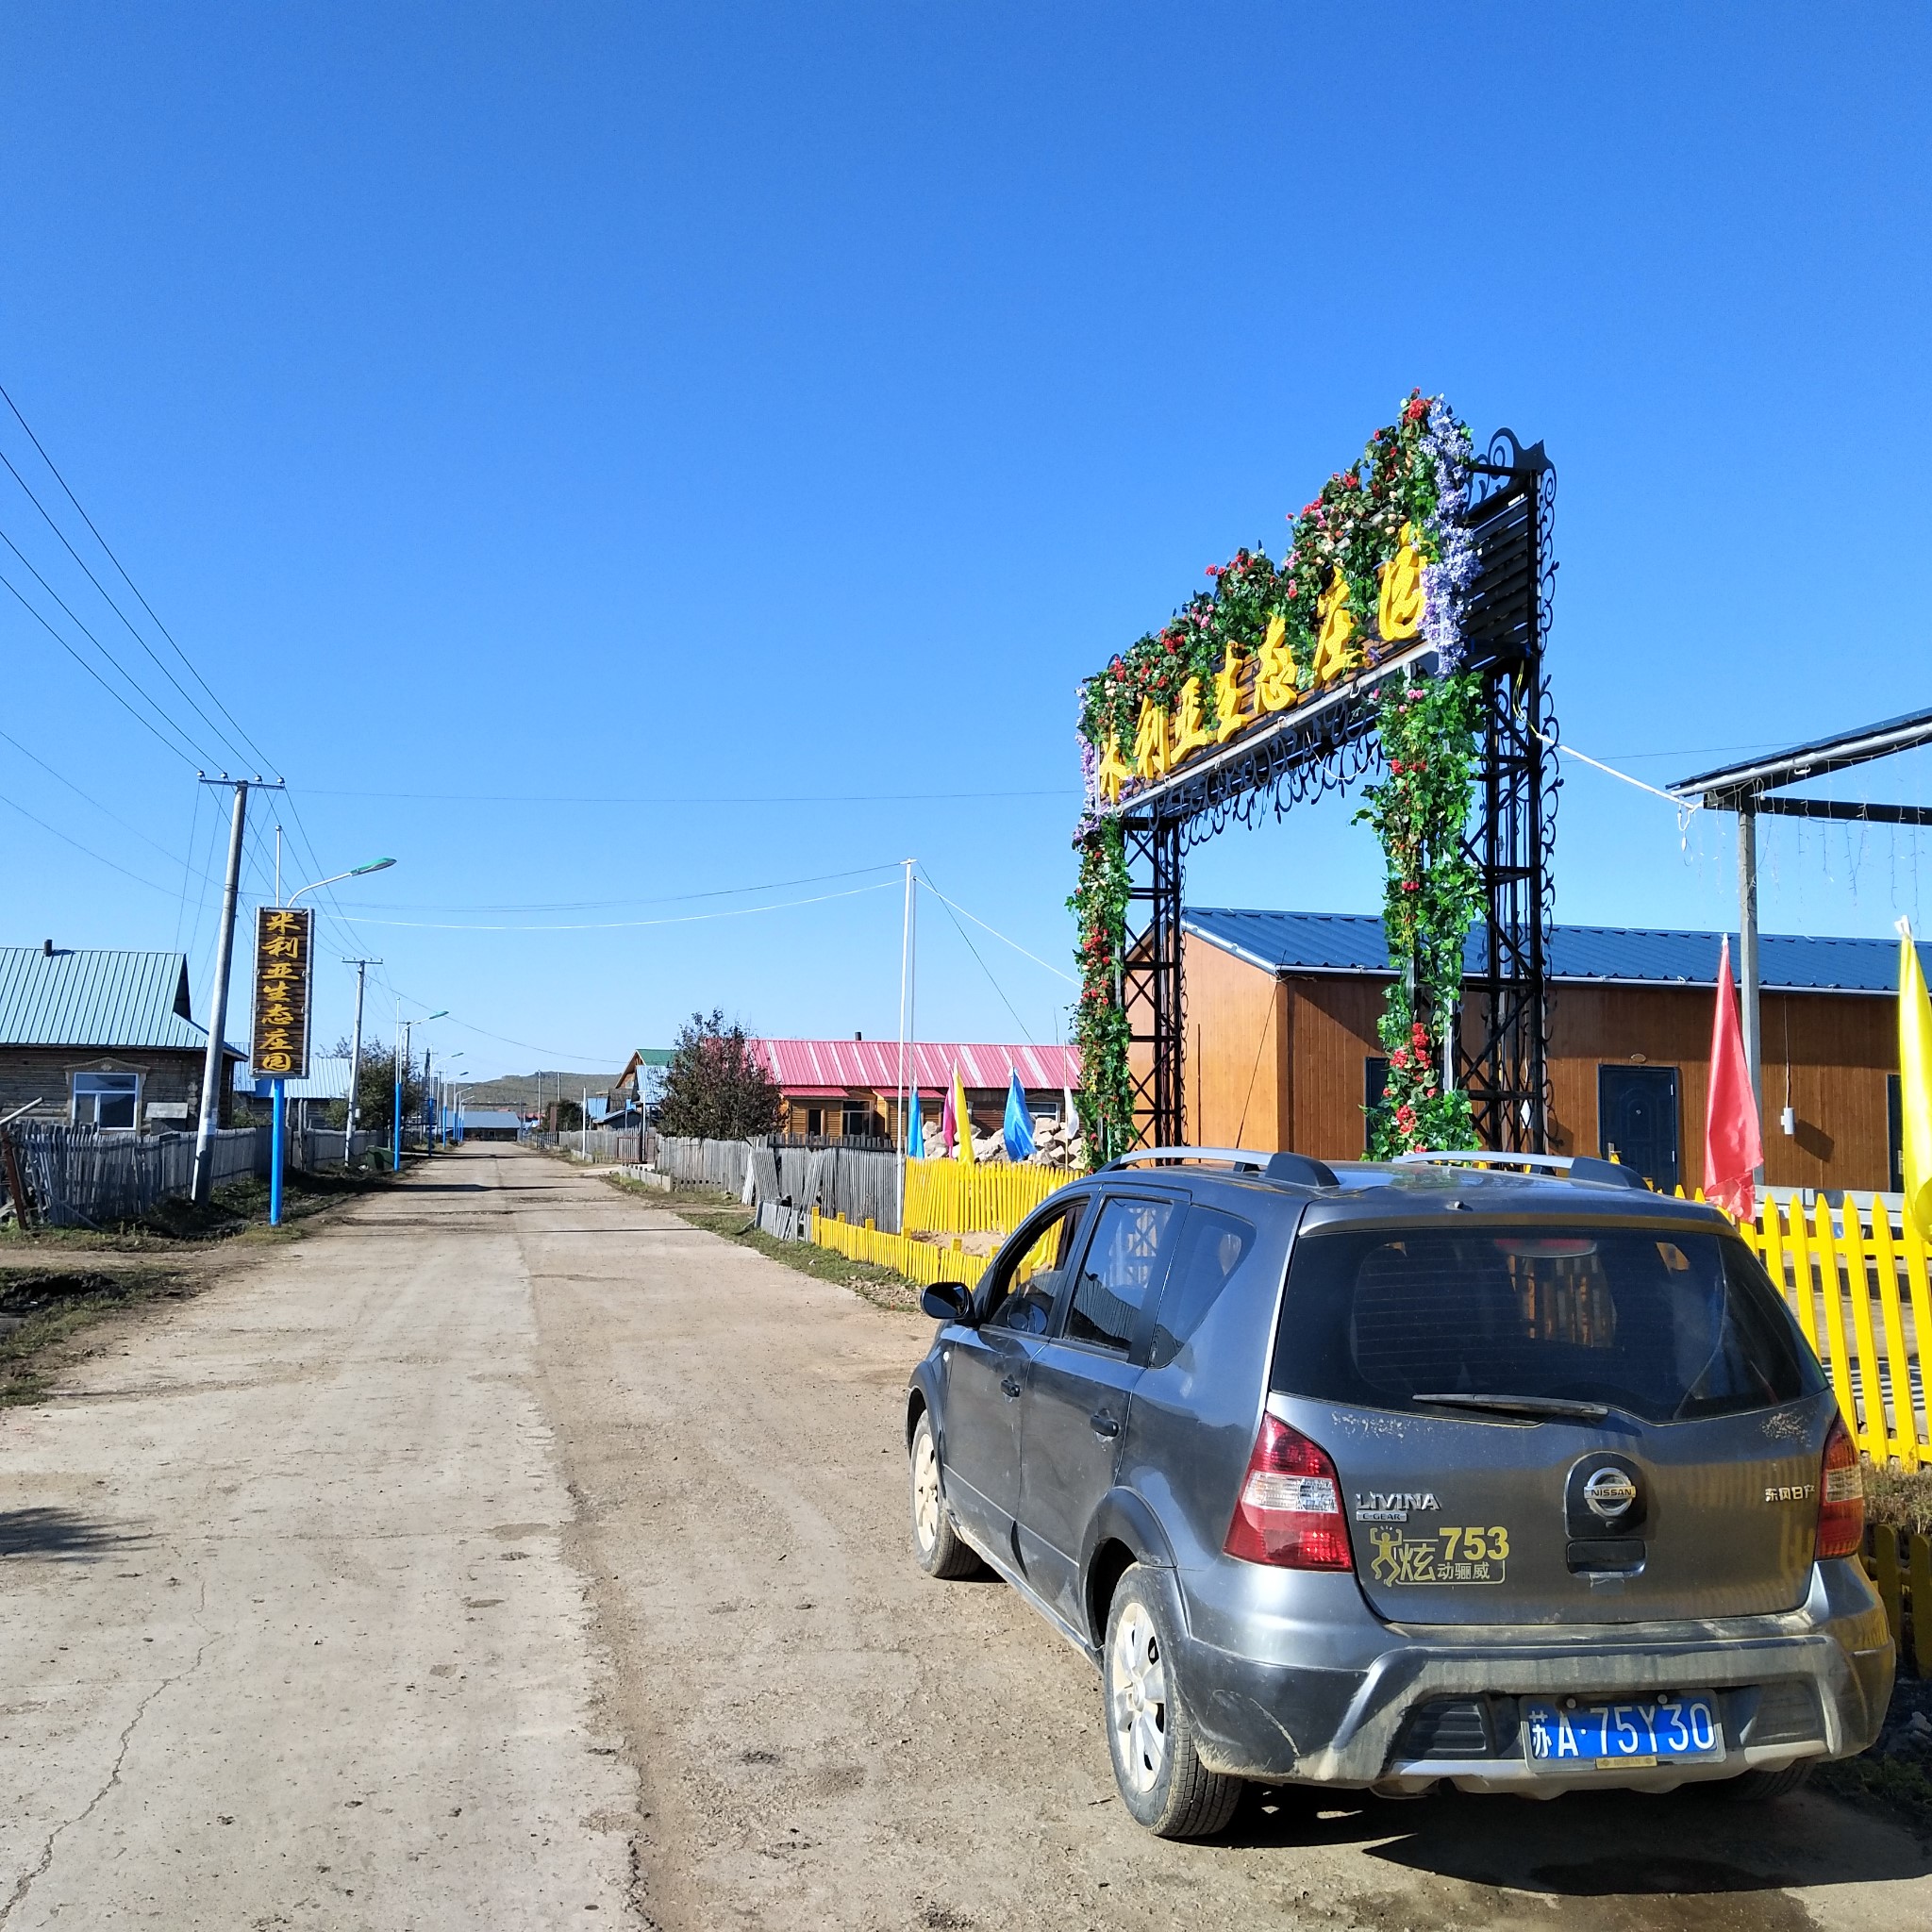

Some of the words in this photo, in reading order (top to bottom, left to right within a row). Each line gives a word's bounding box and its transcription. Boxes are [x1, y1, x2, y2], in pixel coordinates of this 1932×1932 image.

[261, 911, 301, 1072] 米利亚生态庄园
[1356, 1491, 1441, 1510] LIVINA
[1591, 1489, 1632, 1497] NISSAN
[1765, 1484, 1815, 1502] 东风日产
[1439, 1525, 1509, 1561] 753
